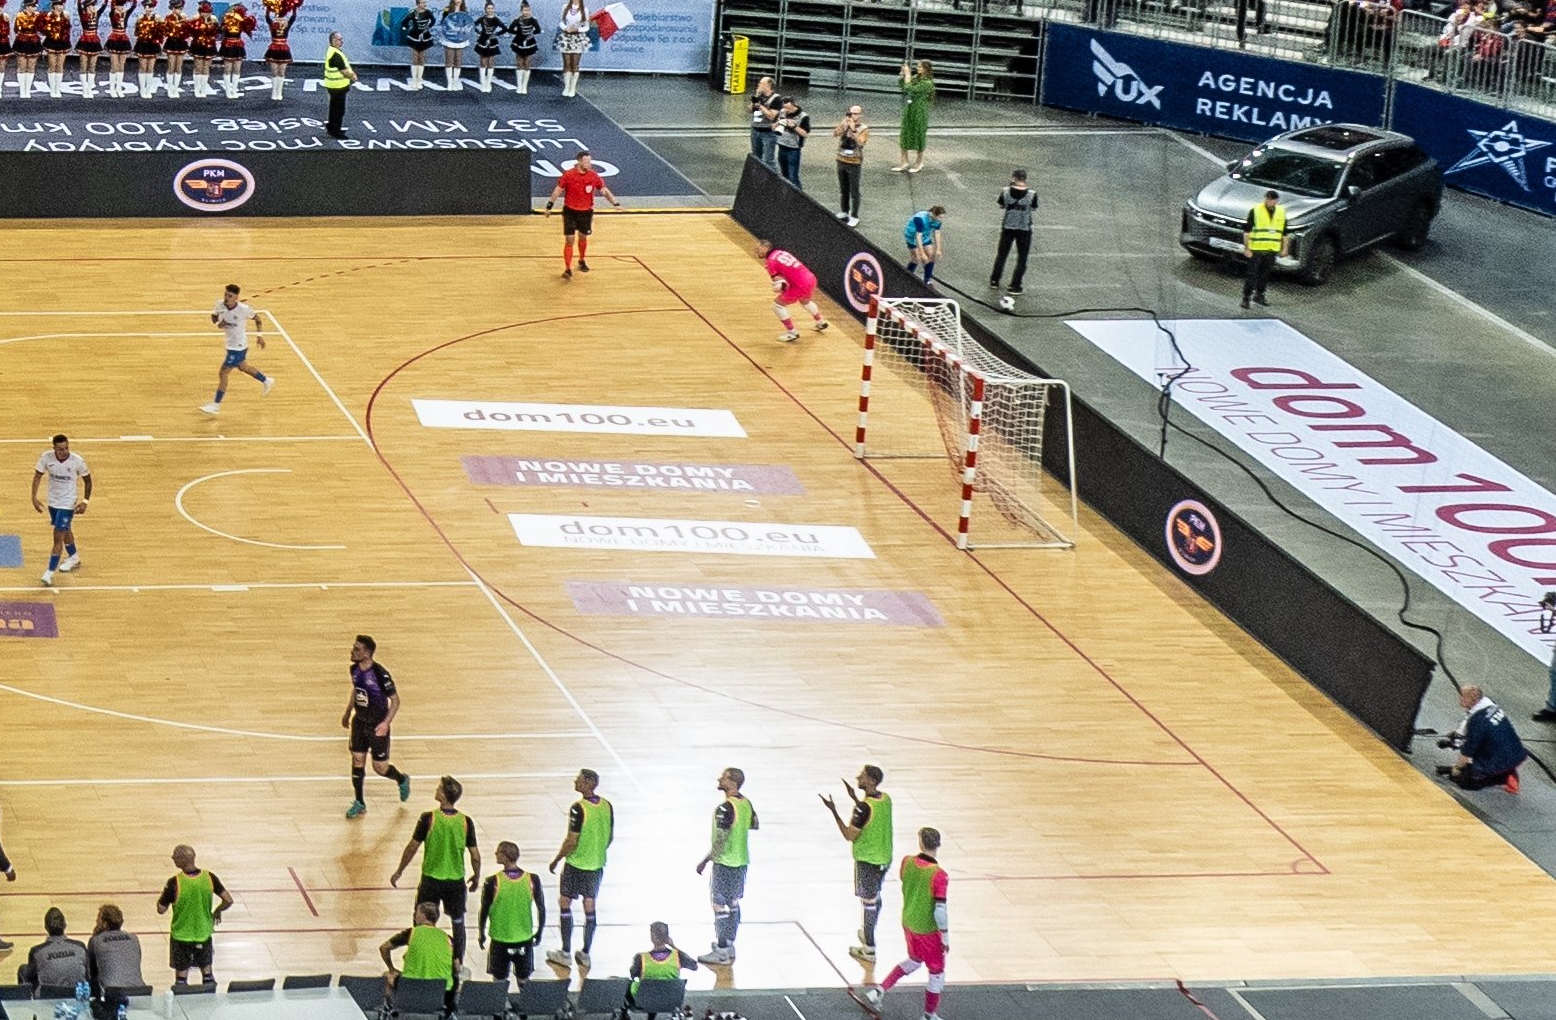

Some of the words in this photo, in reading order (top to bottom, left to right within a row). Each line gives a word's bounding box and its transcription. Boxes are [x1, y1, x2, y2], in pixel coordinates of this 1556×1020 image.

[1197, 70, 1333, 110] AGENCJA
[1, 122, 72, 136] km
[86, 121, 198, 135] 1100
[389, 118, 468, 133] KM
[488, 118, 567, 133] 537
[204, 169, 225, 178] PKM
[463, 410, 696, 428] dom100.eu
[517, 460, 625, 475] NOWE
[633, 464, 736, 480] DOMY
[1247, 432, 1379, 495] DOMY
[537, 471, 755, 491] MIESZKANIA
[560, 521, 820, 544] dom100.eu
[628, 585, 746, 602] NOWE
[754, 589, 865, 606] DOMY
[653, 600, 889, 621] MIESZKANIA
